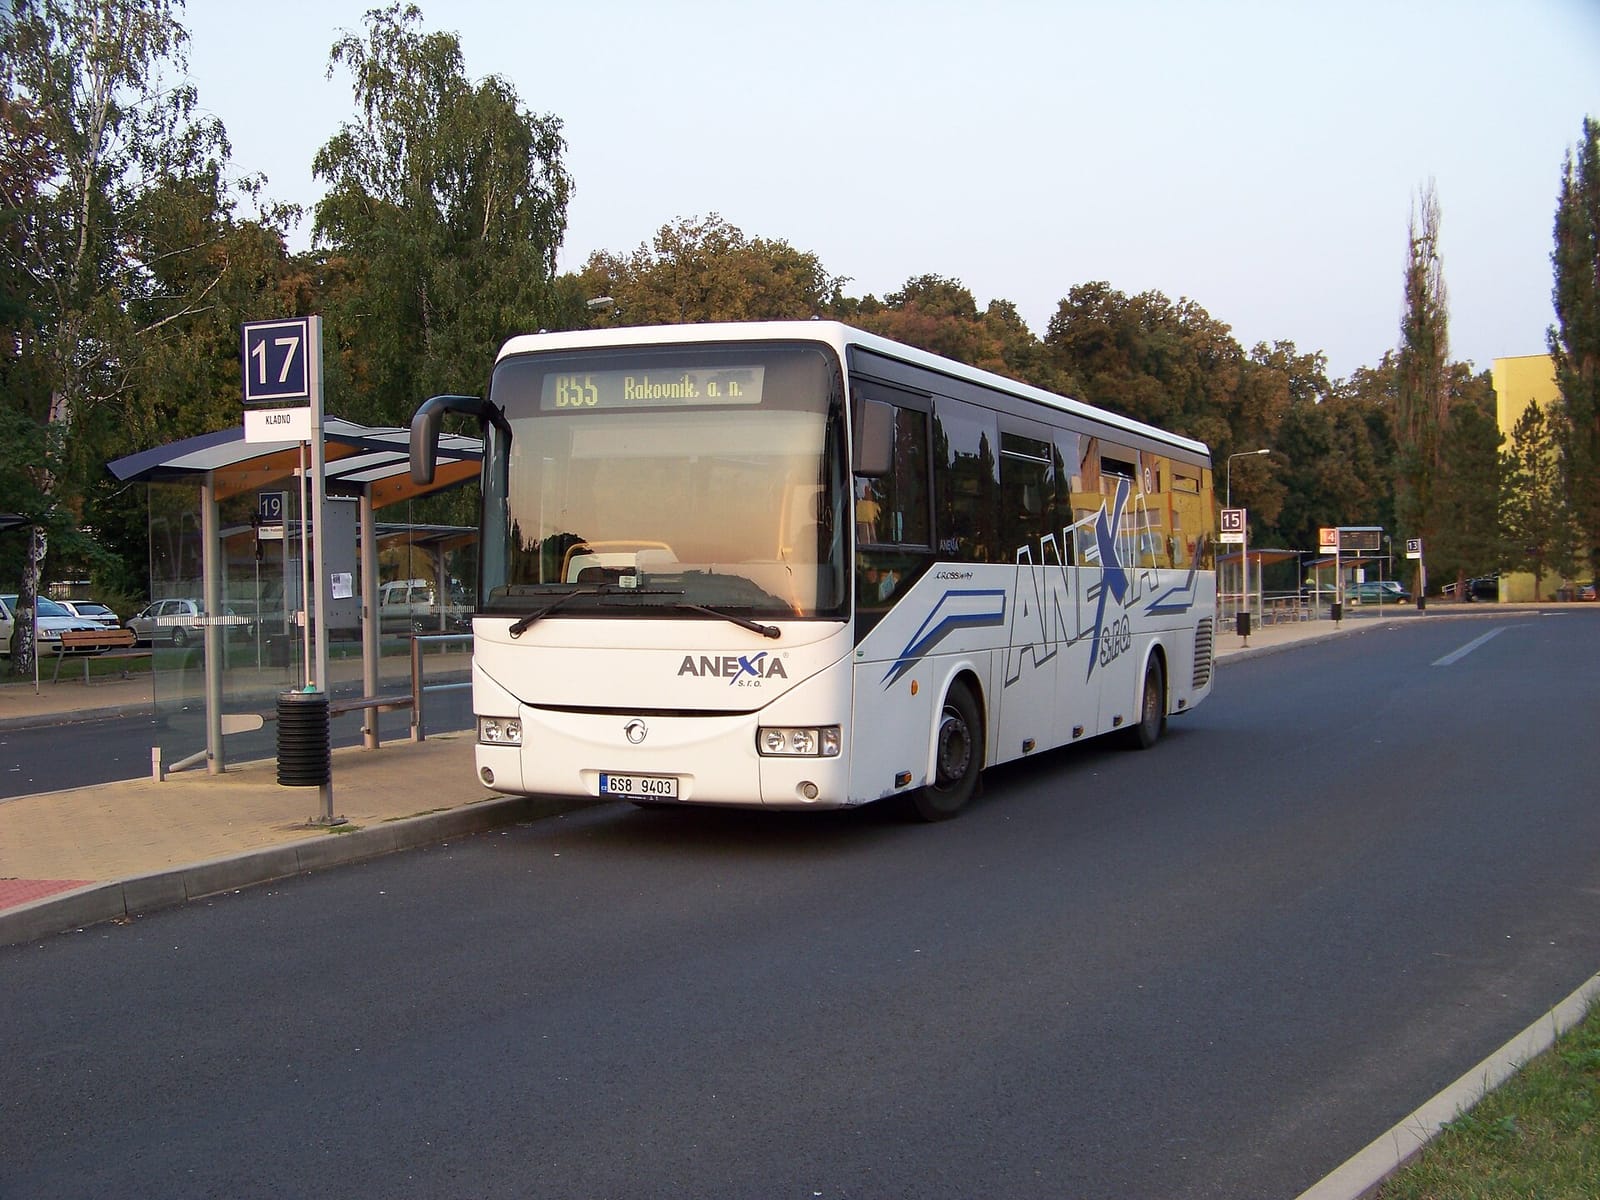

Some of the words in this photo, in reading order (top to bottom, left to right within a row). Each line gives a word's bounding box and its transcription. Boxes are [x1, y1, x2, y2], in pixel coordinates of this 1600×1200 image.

[251, 336, 300, 385] 17
[555, 374, 599, 408] B55
[624, 373, 700, 401] Rakovník,
[706, 381, 721, 398] a.
[727, 380, 744, 397] n.
[265, 414, 291, 425] KLADNO
[262, 497, 281, 517] 19
[1223, 513, 1240, 528] 15
[1408, 541, 1418, 551] 13
[1004, 474, 1160, 688] ANEXIA
[677, 651, 788, 686] ANEXIA
[737, 678, 763, 688] s.r.o.
[610, 777, 632, 792] 6S8
[641, 779, 672, 794] 9403
